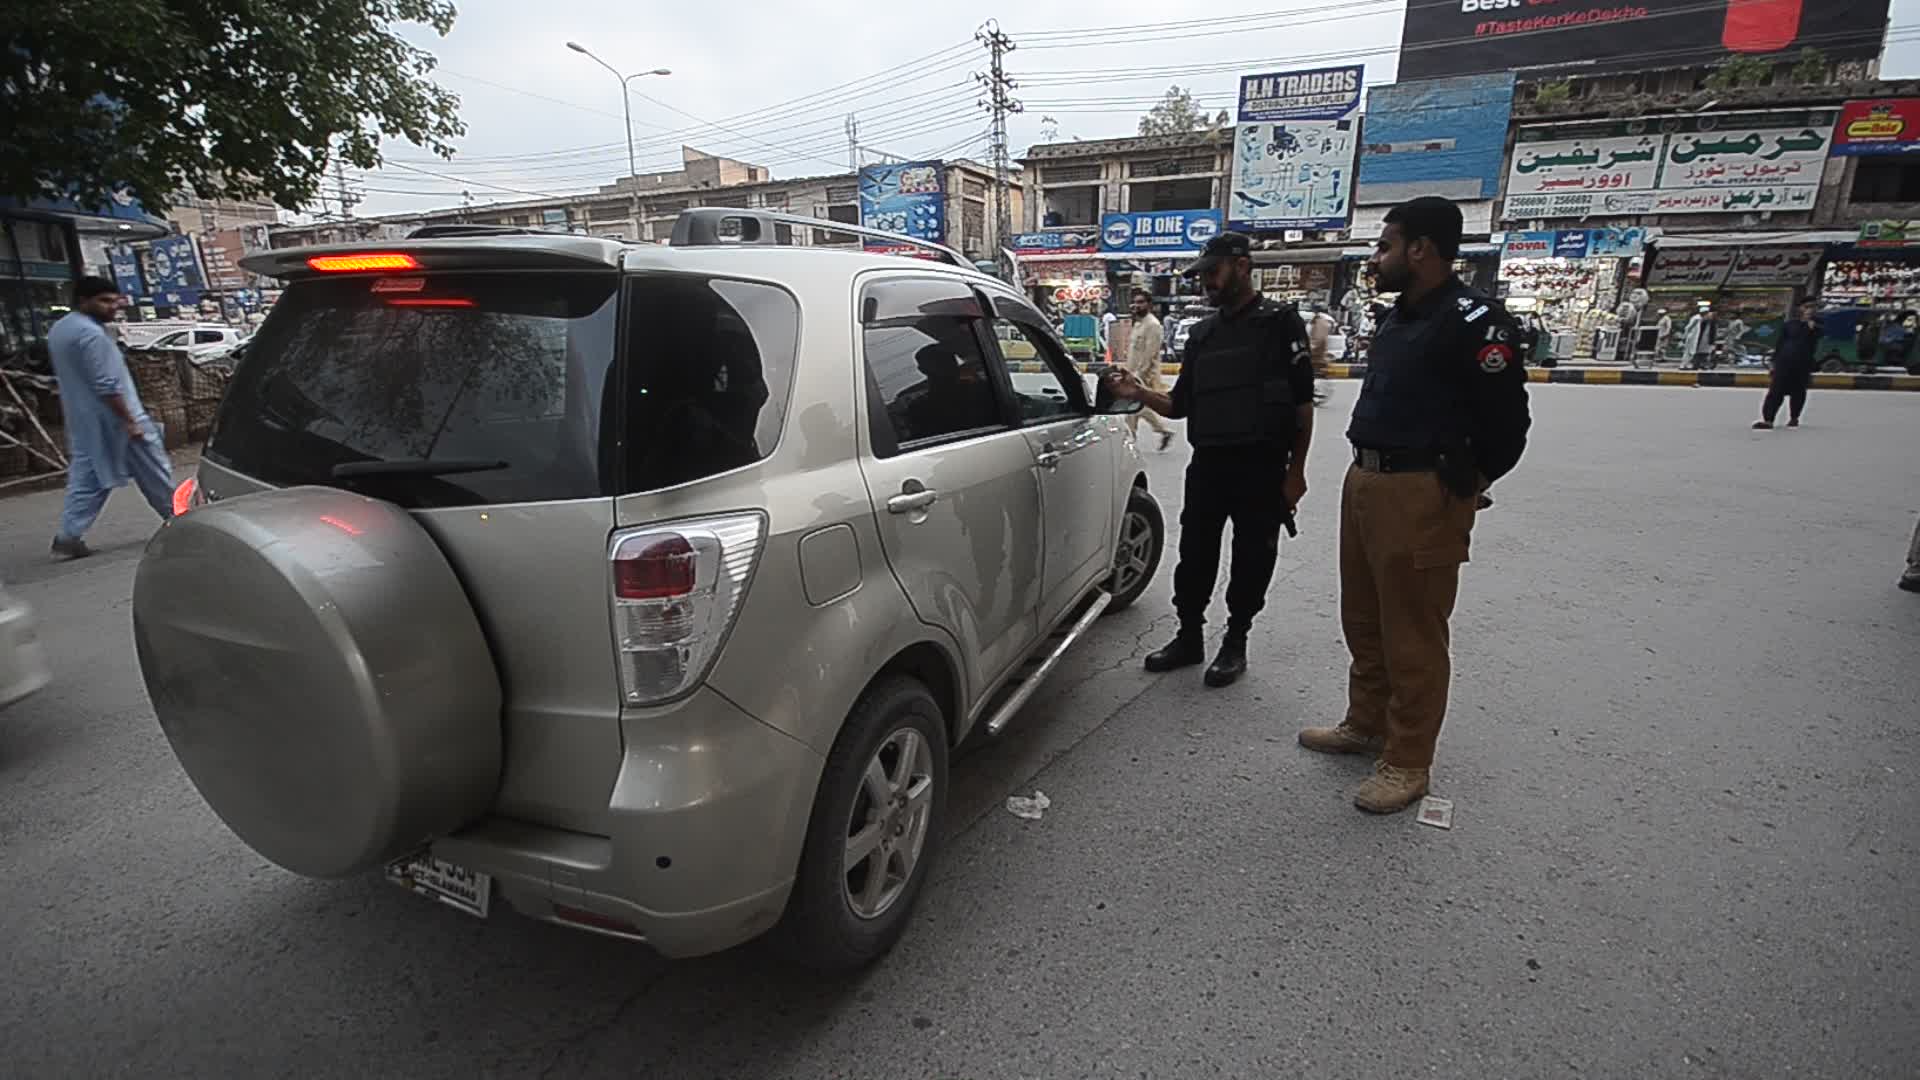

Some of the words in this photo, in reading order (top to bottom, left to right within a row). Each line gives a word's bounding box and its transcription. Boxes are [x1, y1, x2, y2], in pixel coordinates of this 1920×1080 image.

[1246, 77, 1273, 100] H.N
[1278, 70, 1357, 97] TRADERS
[1516, 137, 1656, 174] شریفین
[1670, 129, 1825, 164] حرمین
[1155, 215, 1184, 234] ONE
